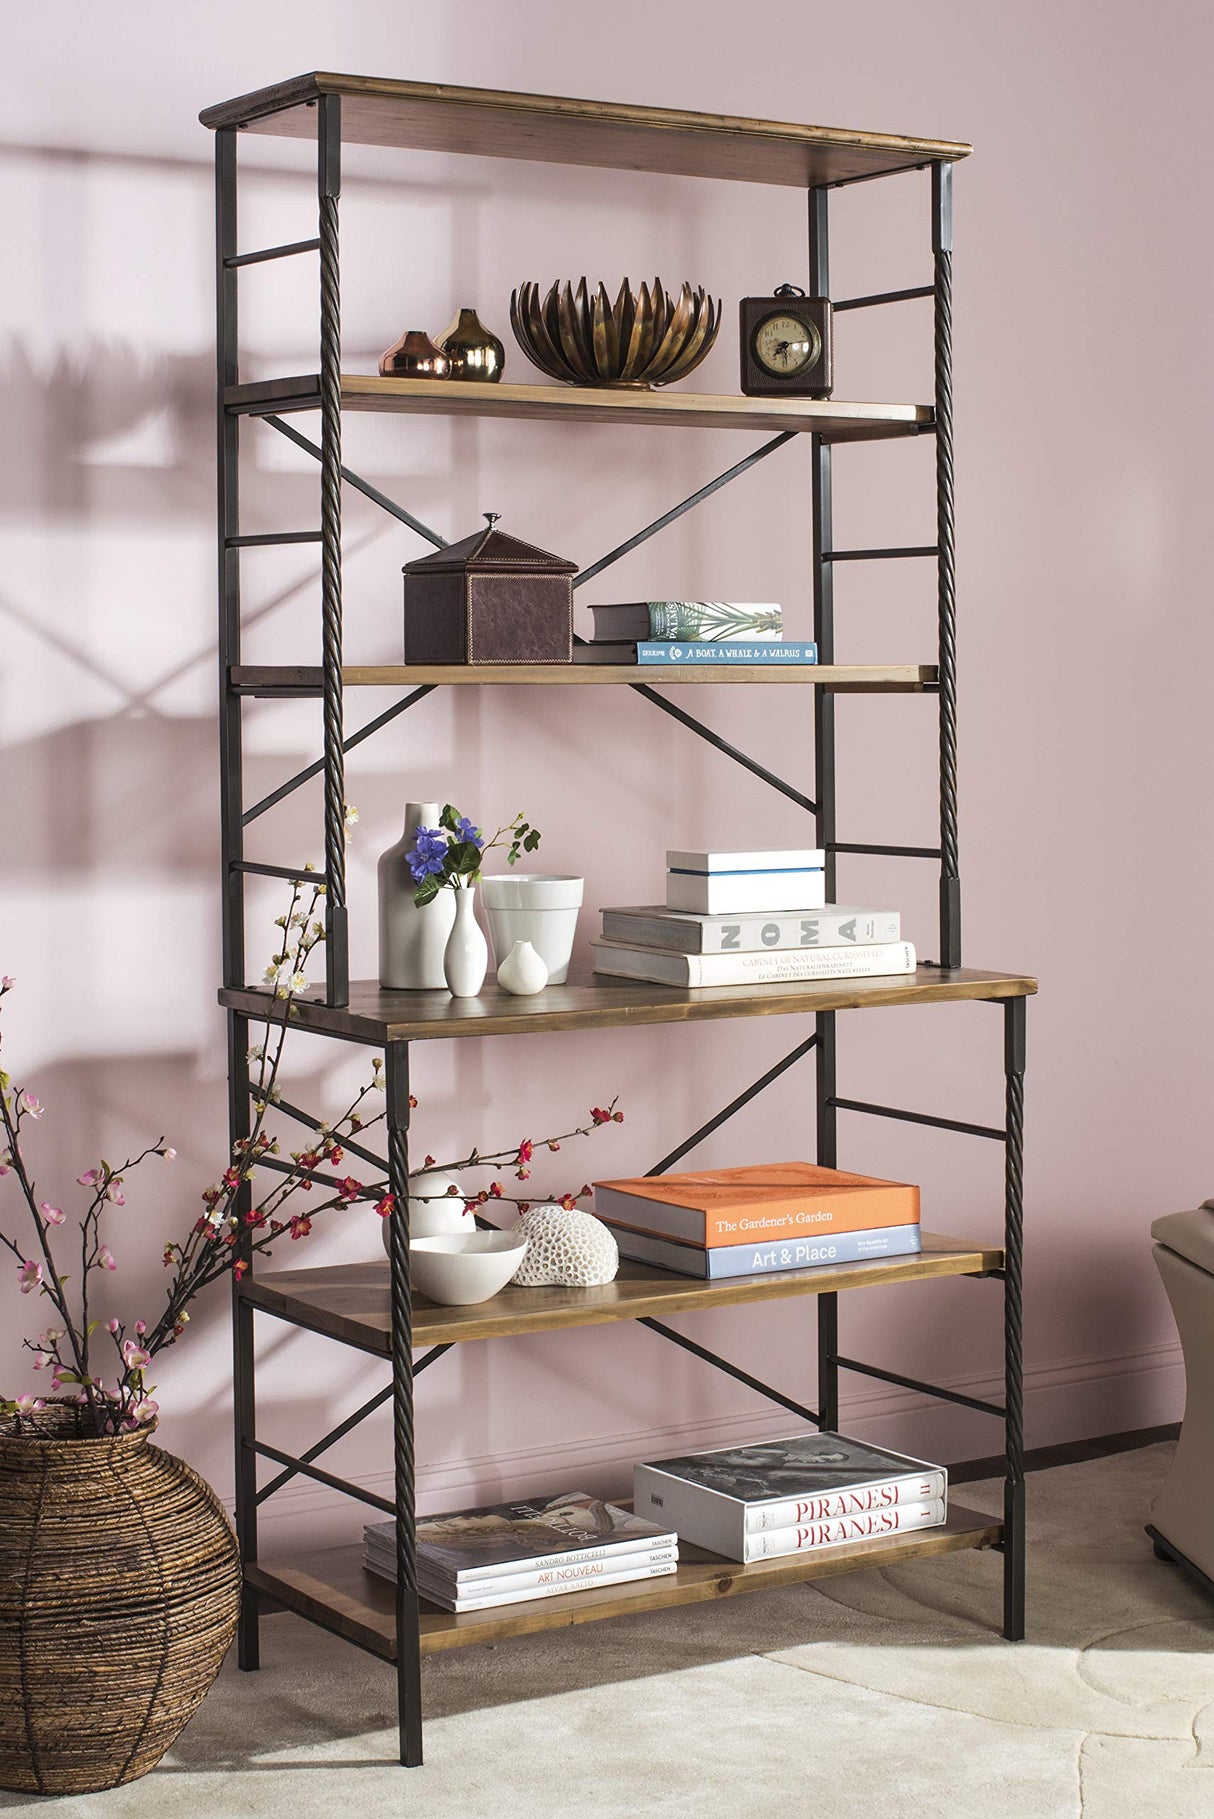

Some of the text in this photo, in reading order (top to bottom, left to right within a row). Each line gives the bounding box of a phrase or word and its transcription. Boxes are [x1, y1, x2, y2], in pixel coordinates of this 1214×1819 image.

[669, 602, 678, 639] PALMS
[685, 649, 693, 659] A
[718, 649, 725, 658] A
[725, 649, 752, 658] WHALE
[753, 649, 760, 658] &
[761, 649, 768, 658] A
[769, 649, 800, 658] WALRUS
[742, 956, 778, 967] CABINET
[716, 1210, 833, 1233] The Gardener's Garden
[752, 1245, 837, 1268] Art & Place
[796, 1485, 900, 1522] PIRANESI
[796, 1511, 900, 1548] PIRANESI
[534, 1549, 606, 1568] SANDRO BOTTICELLI
[649, 1553, 672, 1562] TASCHEN
[537, 1563, 604, 1584] ART NOUVEAU
[650, 1566, 671, 1574] TASCHEN
[546, 1579, 594, 1595] ALVAR AALTO
